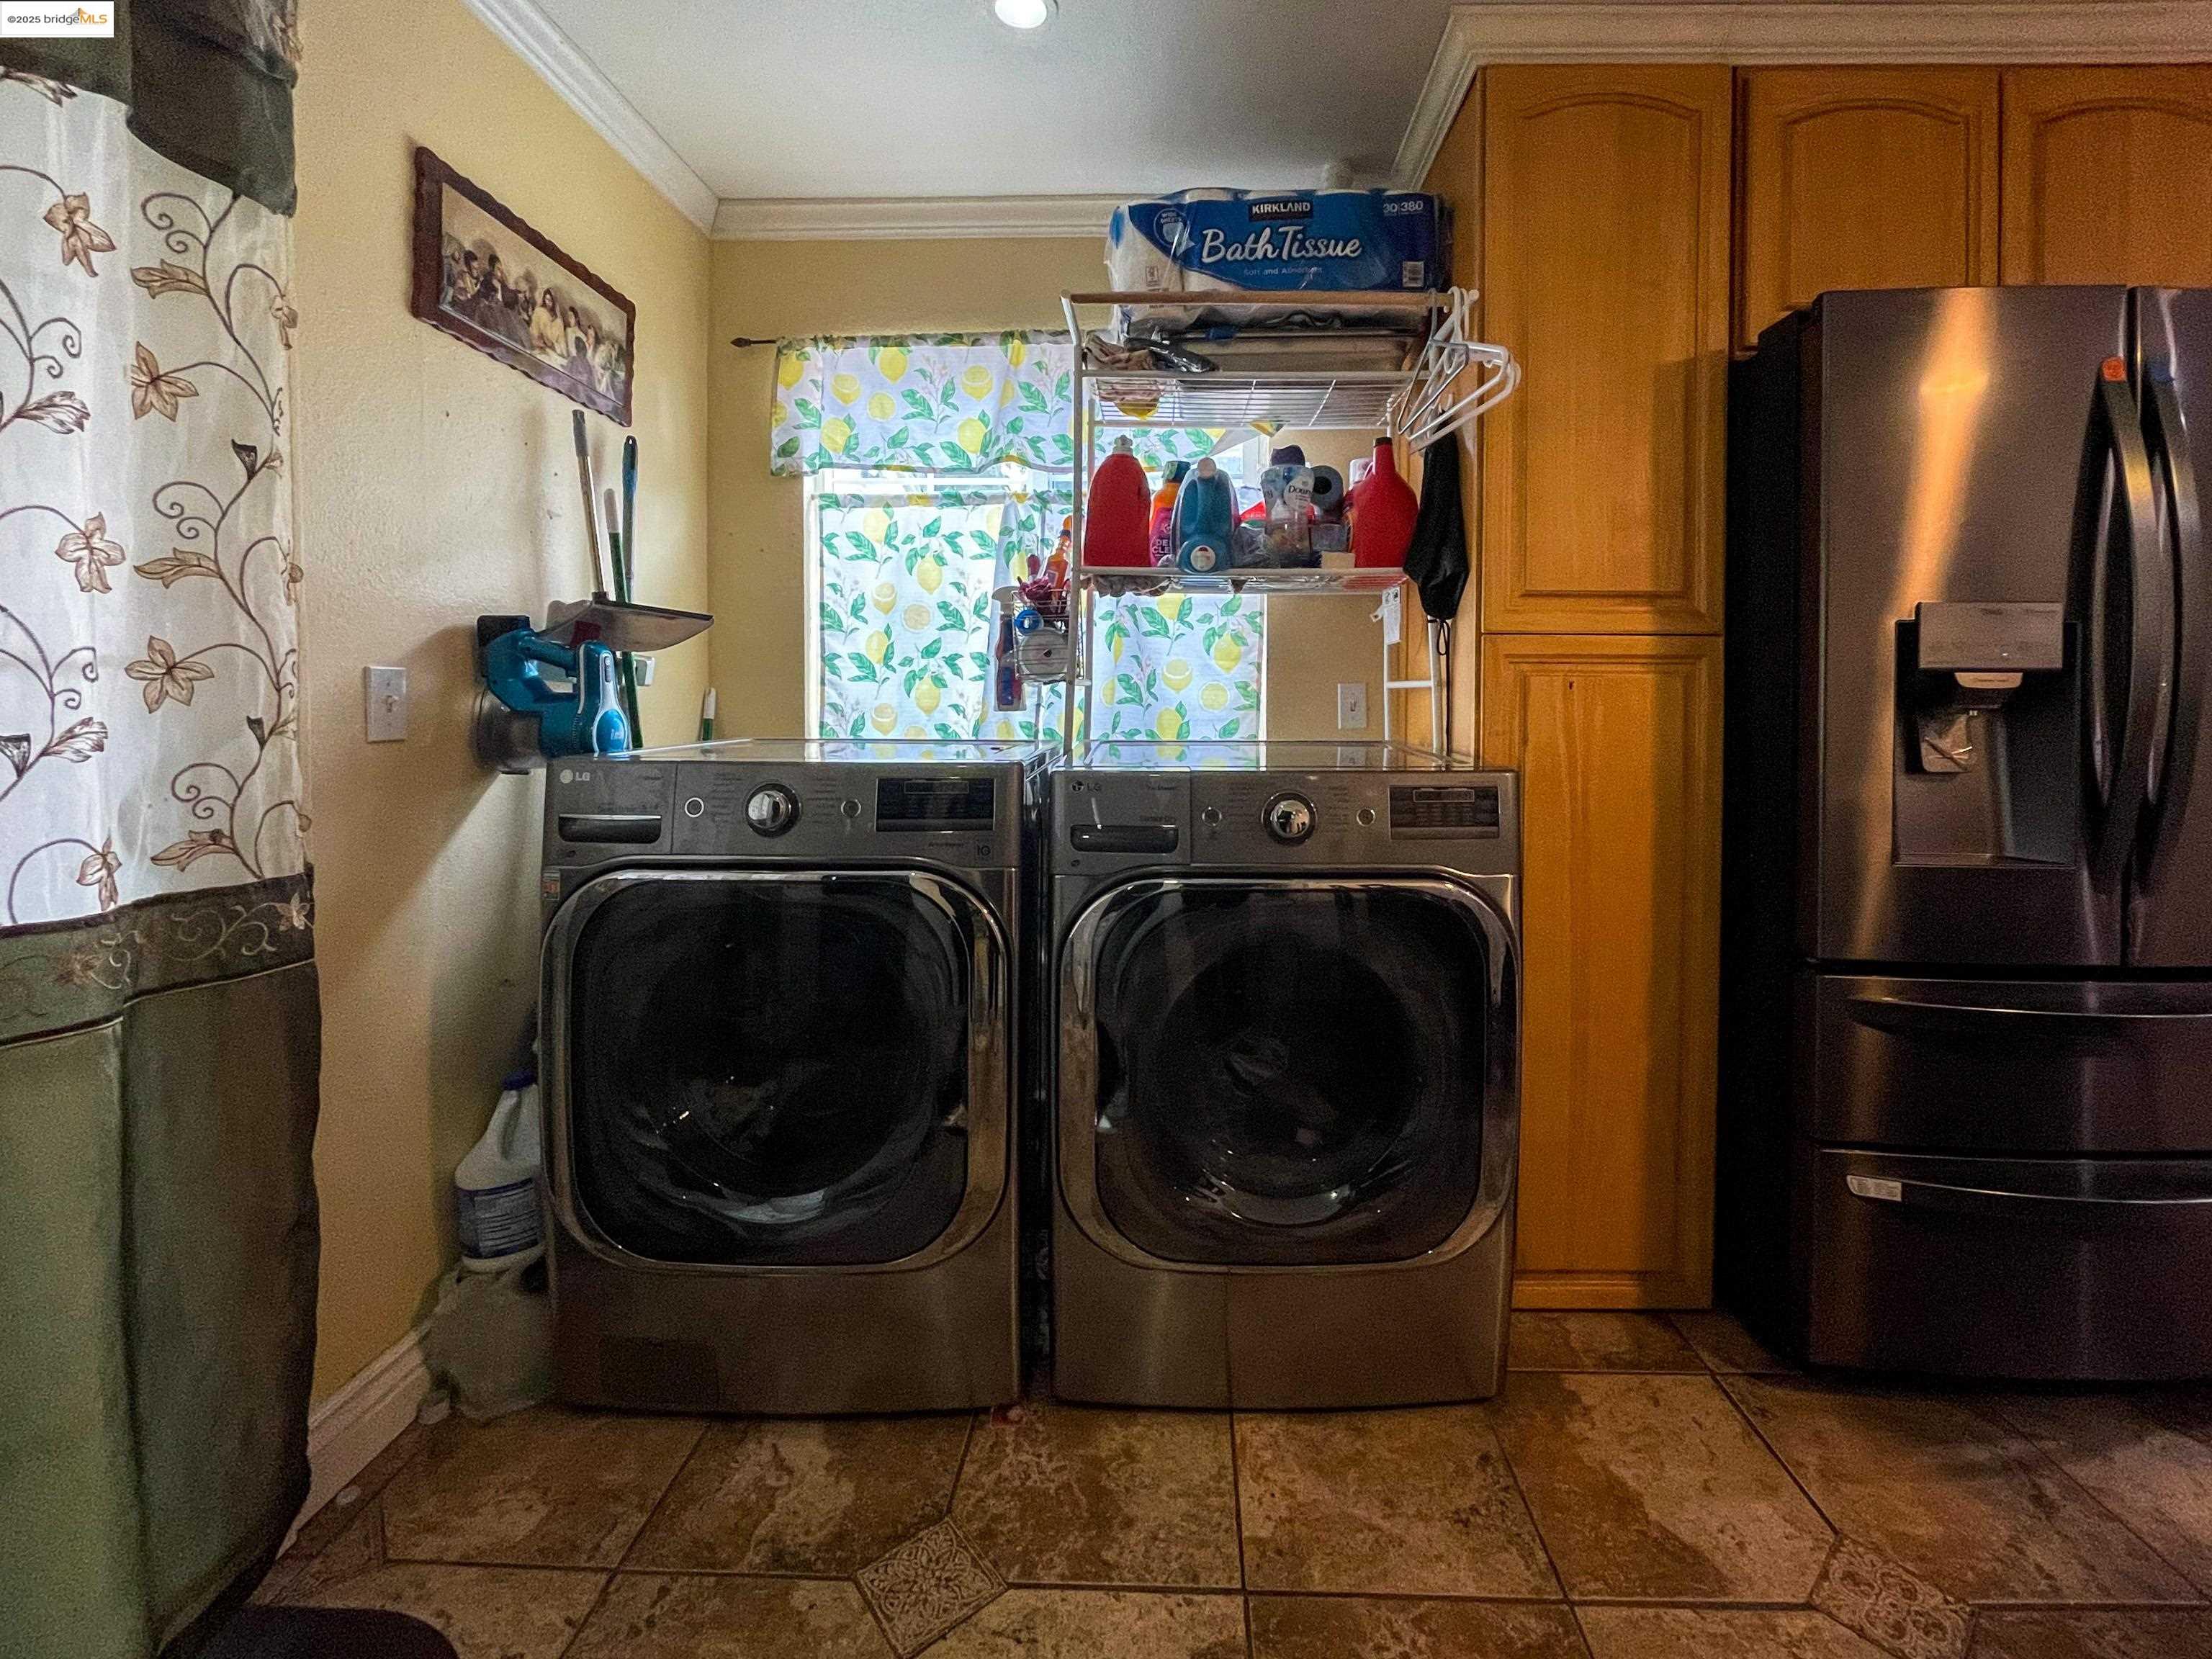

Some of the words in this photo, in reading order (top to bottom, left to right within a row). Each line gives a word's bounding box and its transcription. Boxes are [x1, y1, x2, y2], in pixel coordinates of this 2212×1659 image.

[1251, 202, 1311, 215] KIRKLAND
[1200, 226, 1280, 264] Bath
[1278, 225, 1363, 261] Tissue
[575, 771, 591, 781] LG
